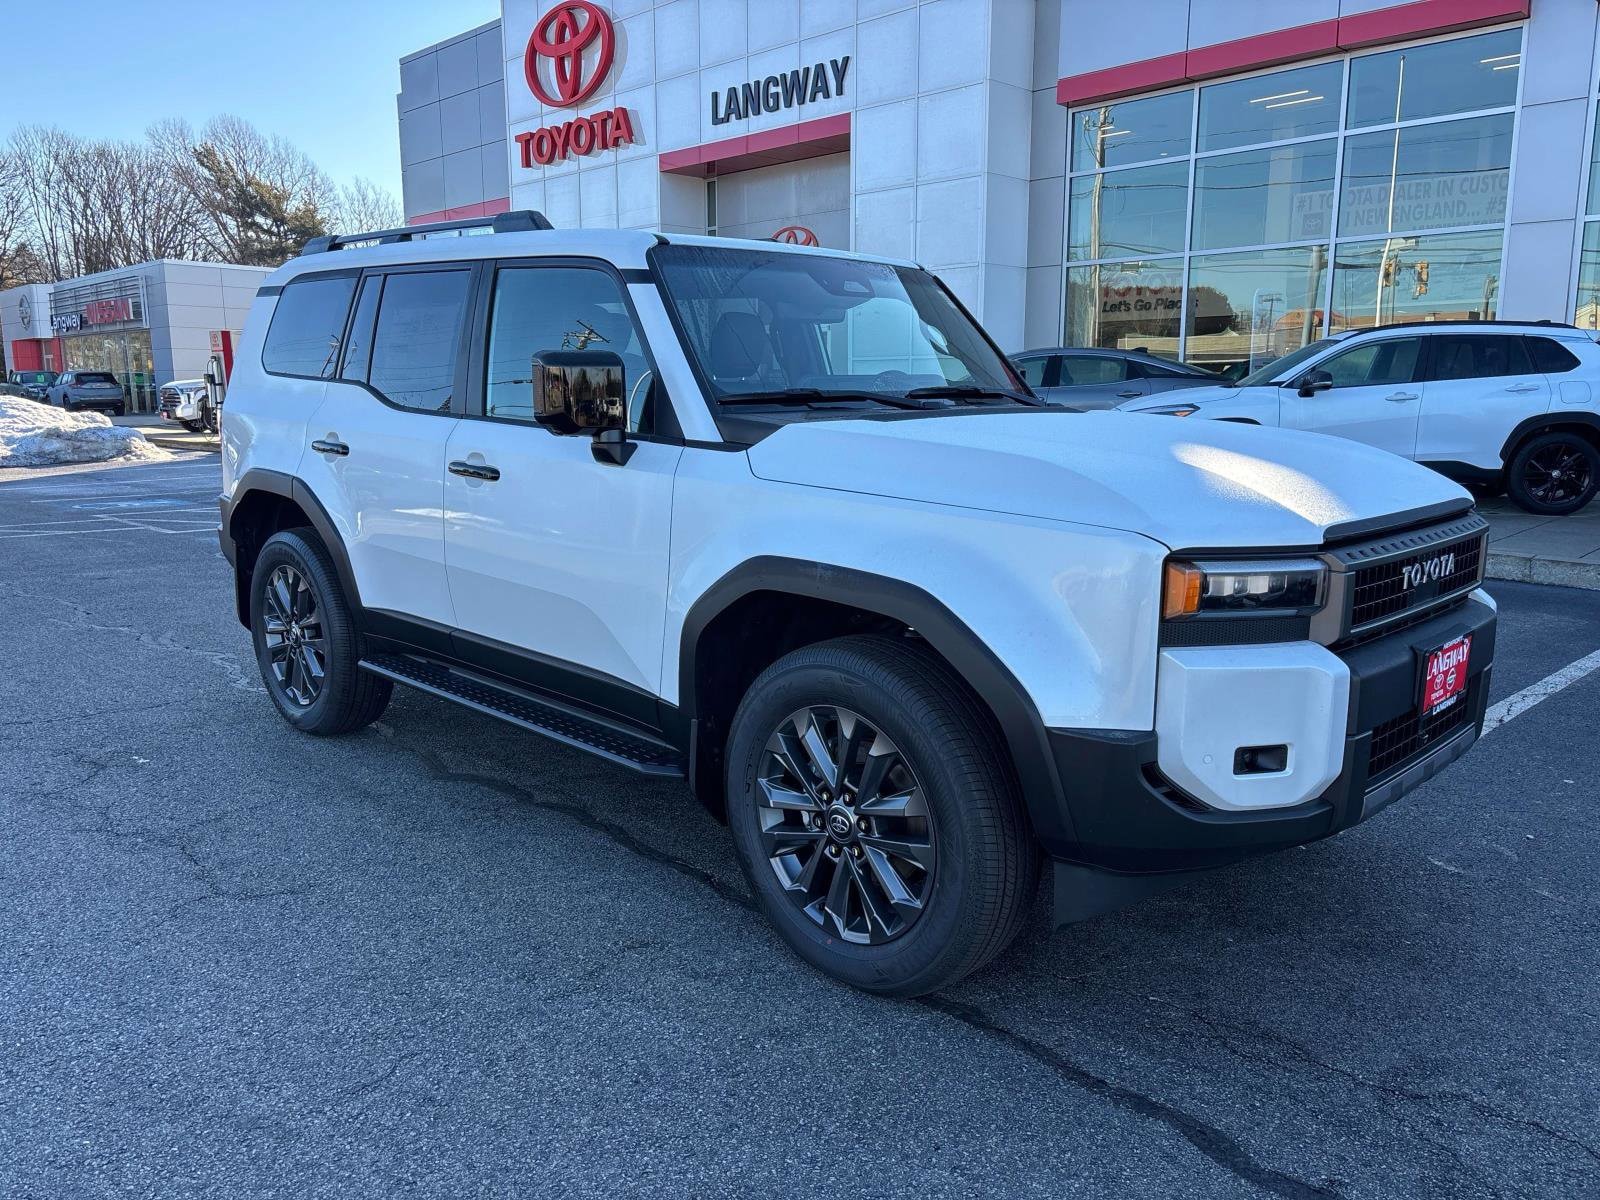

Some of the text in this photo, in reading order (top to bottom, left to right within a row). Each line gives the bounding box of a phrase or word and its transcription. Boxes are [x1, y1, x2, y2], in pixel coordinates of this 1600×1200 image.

[711, 55, 850, 126] LANGWAY
[515, 107, 634, 168] TOYOTA
[1436, 178, 1455, 198] IN
[86, 298, 134, 325] NISSAN
[1102, 300, 1132, 313] Let's
[1133, 298, 1152, 312] Go
[50, 312, 82, 333] Langway
[1402, 553, 1455, 590] TOYOTA
[1426, 643, 1470, 681] LANGWAY
